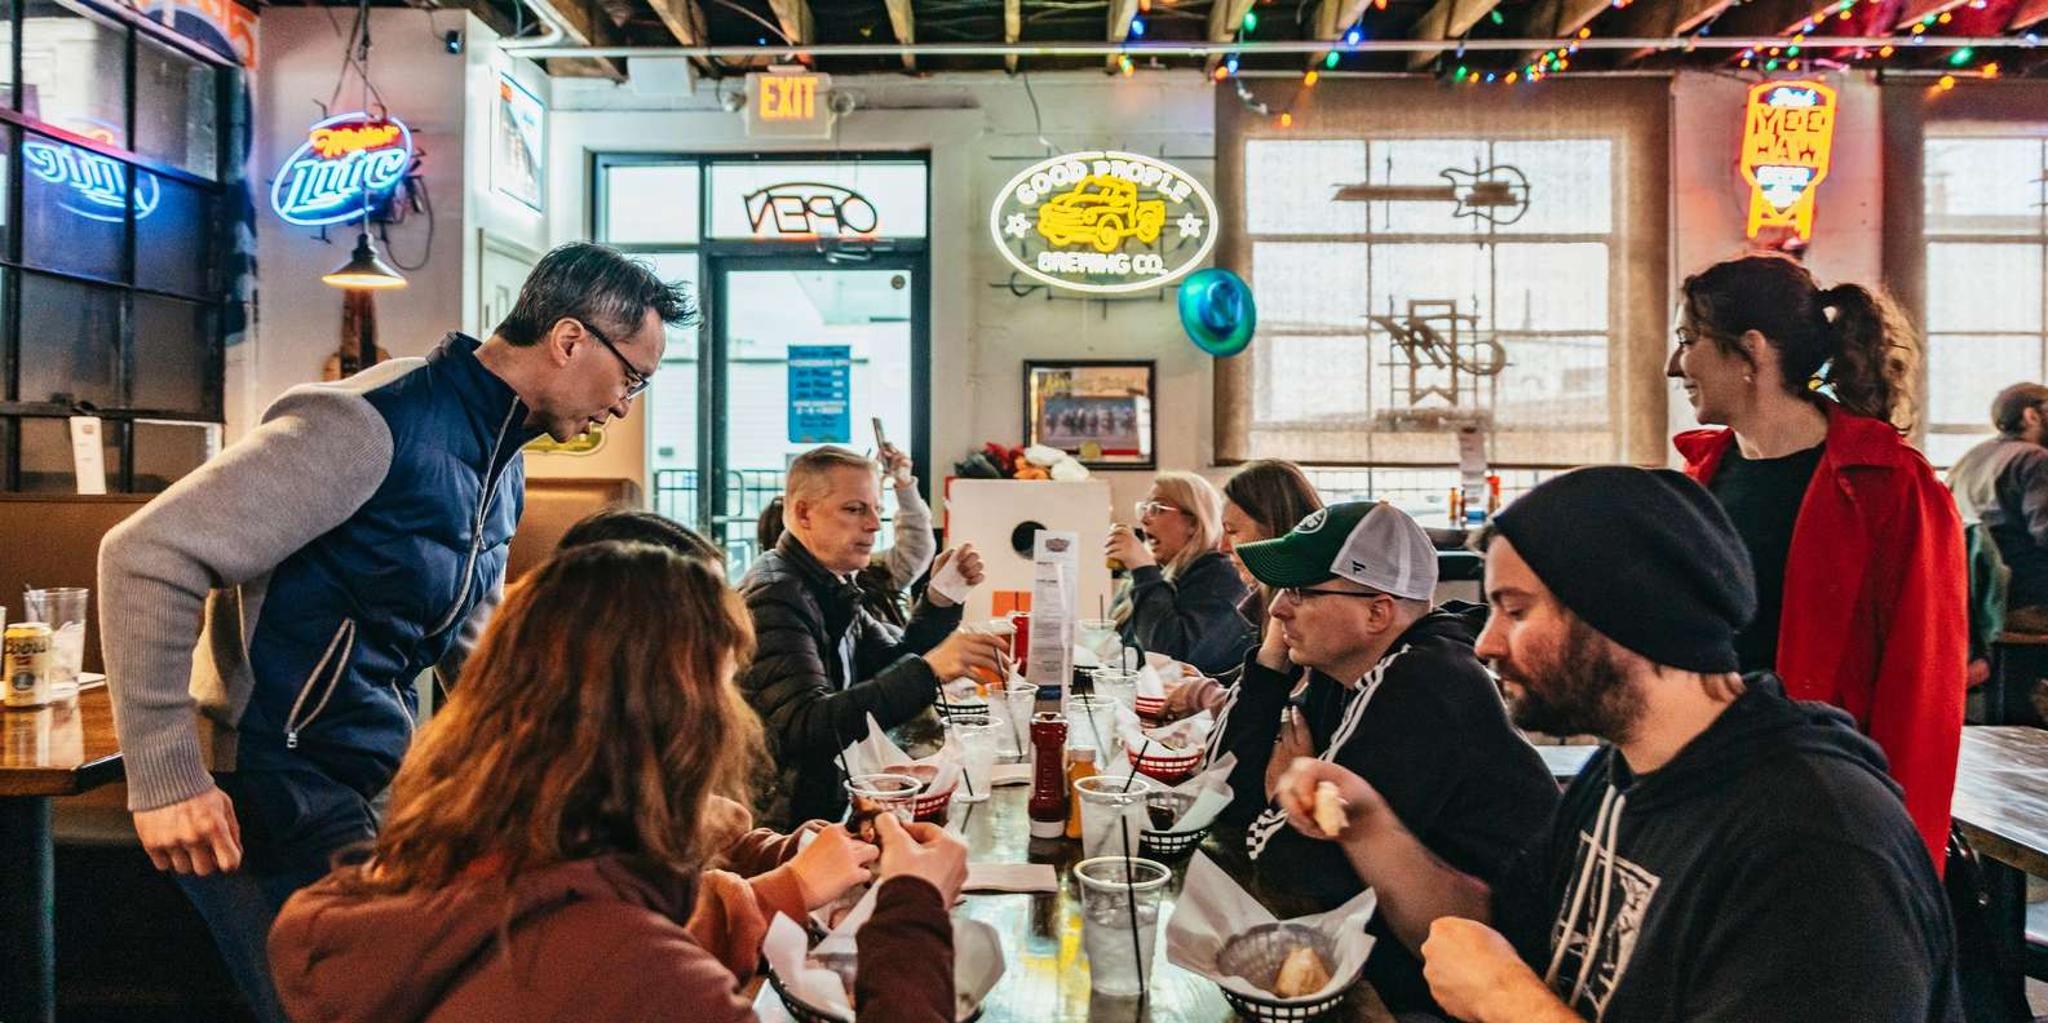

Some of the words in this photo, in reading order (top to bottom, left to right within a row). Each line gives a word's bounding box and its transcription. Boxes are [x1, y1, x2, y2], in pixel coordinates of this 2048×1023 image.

[759, 76, 818, 121] EXIT
[1753, 107, 1828, 135] YEE
[310, 125, 400, 159] Miller
[1754, 135, 1822, 164] HAW
[280, 149, 406, 214] Lite
[1016, 160, 1088, 205] GOOD
[1093, 160, 1192, 204] PEOPLE
[1038, 252, 1131, 274] BREWING
[1132, 254, 1169, 276] CO.
